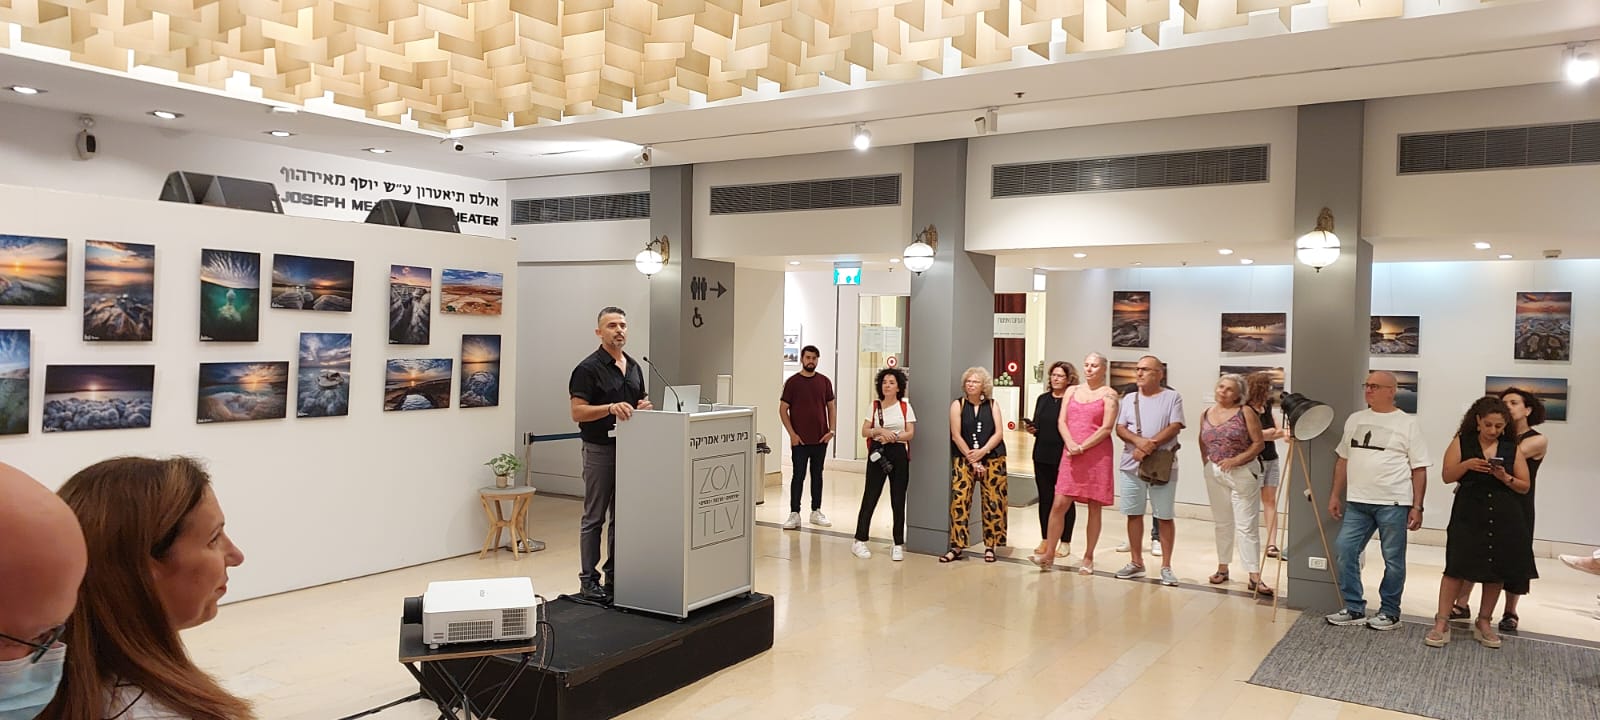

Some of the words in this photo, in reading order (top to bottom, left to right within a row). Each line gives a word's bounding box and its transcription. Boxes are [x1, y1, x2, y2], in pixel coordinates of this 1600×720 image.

[280, 166, 346, 186] מאירהוף
[350, 177, 379, 191] יוסף
[281, 191, 346, 209] JOSEPH
[416, 186, 465, 203] תיאטרון
[469, 192, 499, 207] אולם
[690, 434, 719, 450] אמריקה
[720, 433, 735, 443] ציוני
[736, 431, 749, 440] בית
[699, 464, 740, 494] ZOA
[698, 506, 740, 537] TLV
